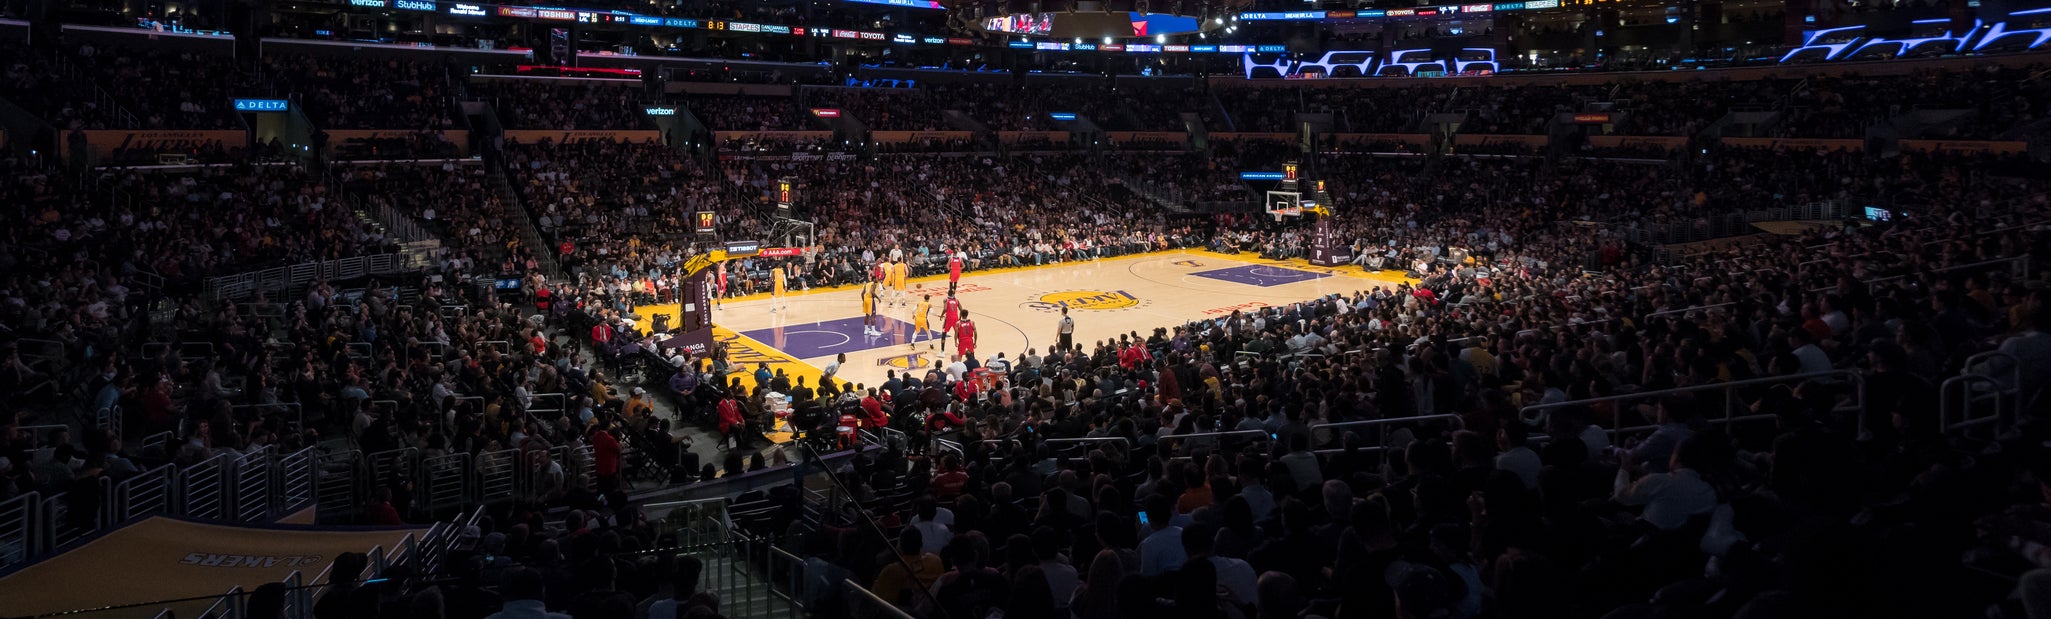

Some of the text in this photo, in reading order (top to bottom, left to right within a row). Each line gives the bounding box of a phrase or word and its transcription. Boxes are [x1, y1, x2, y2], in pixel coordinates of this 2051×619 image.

[398, 1, 432, 10] StubHub
[1526, 1, 1557, 9] STAPLES
[540, 10, 575, 19] TOSHIBA
[708, 21, 725, 30] 8:13
[731, 22, 760, 31] STAPLES
[861, 32, 885, 40] TOYOTA
[646, 107, 674, 115] verizon
[178, 552, 323, 569] LAKERS
